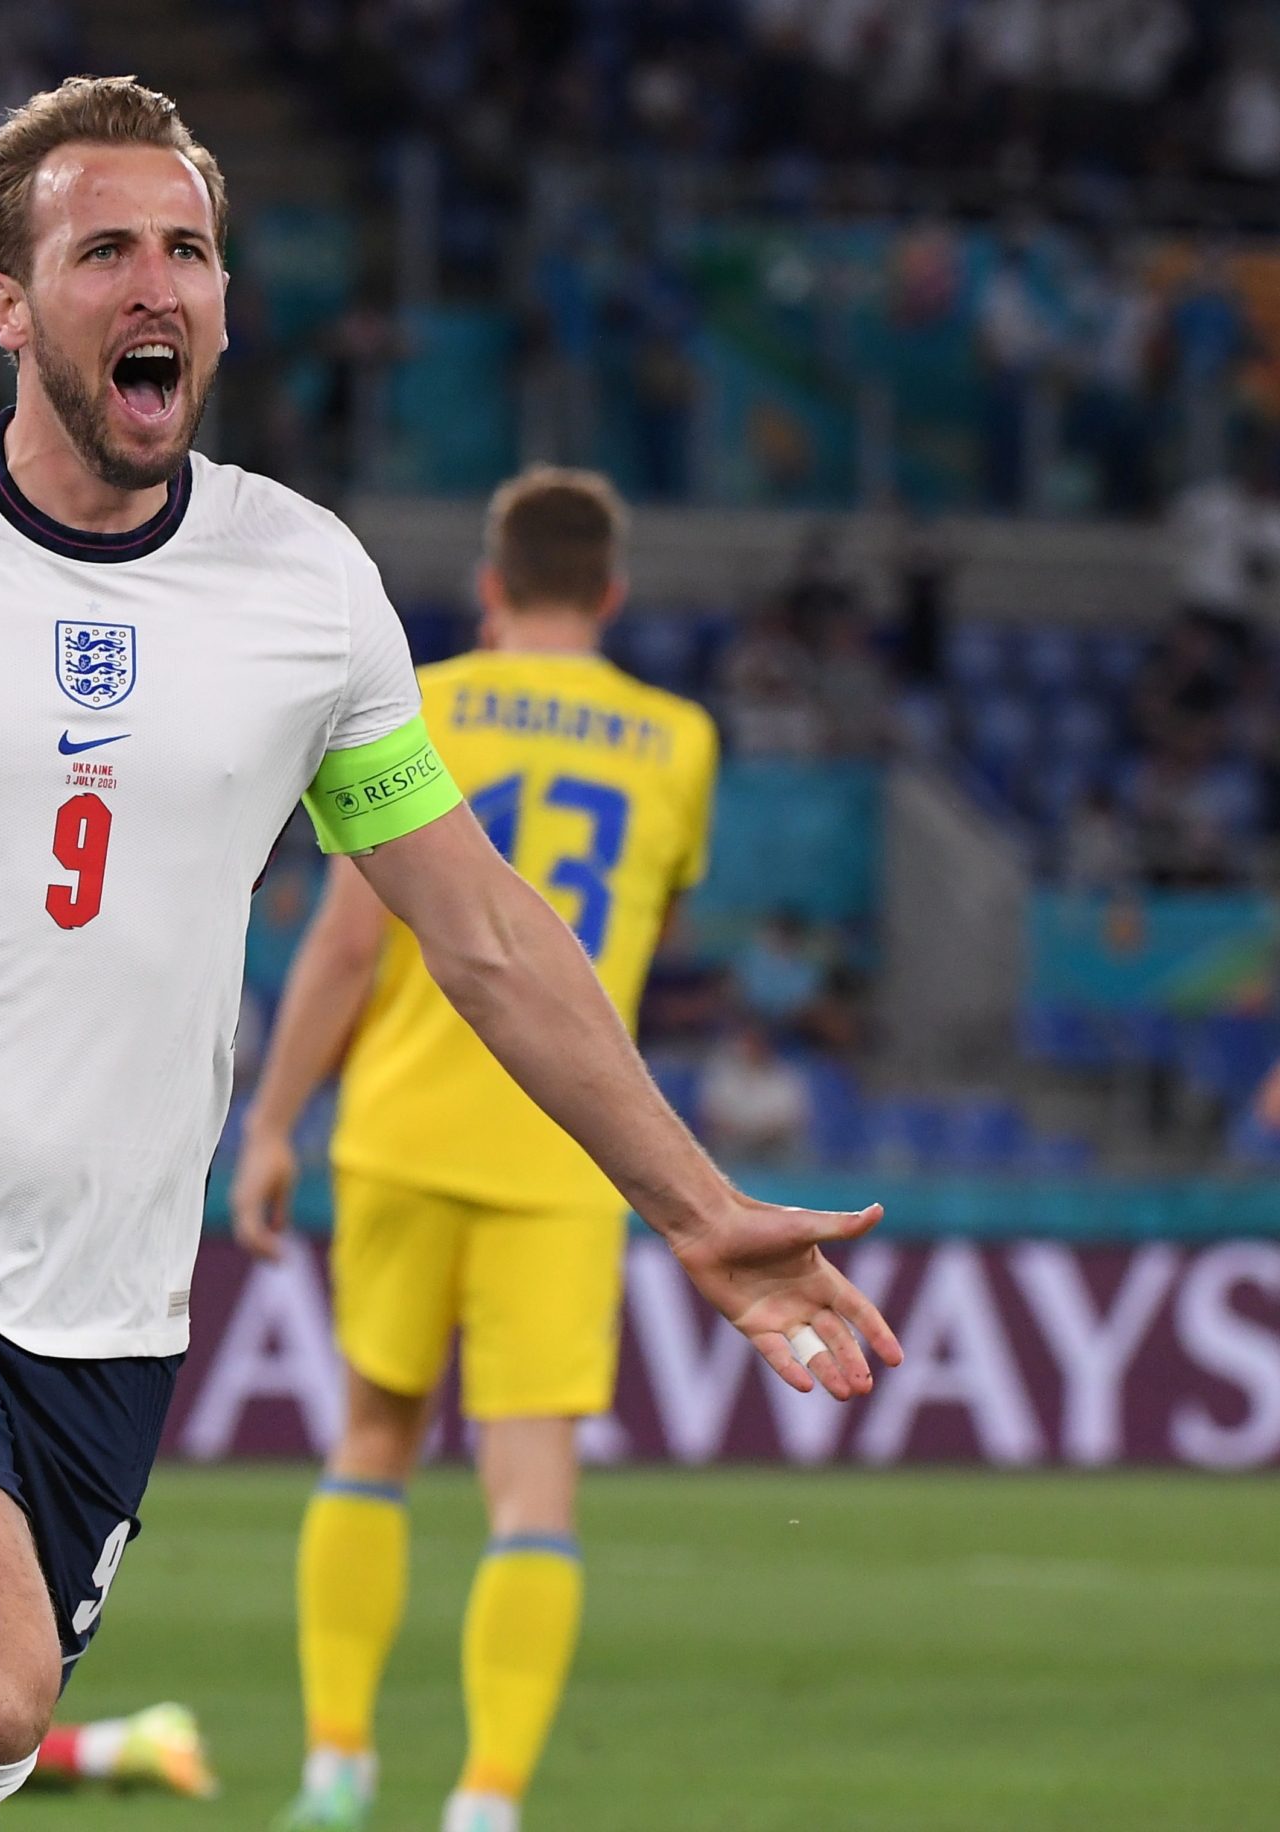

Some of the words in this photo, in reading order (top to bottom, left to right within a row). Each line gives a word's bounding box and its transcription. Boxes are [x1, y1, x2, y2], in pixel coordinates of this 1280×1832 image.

[65, 775, 71, 785] 3
[73, 776, 96, 787] JULY
[97, 778, 117, 789] 2021
[72, 762, 113, 776] UKRAINE
[363, 750, 438, 804] RESPEC
[45, 792, 112, 930] 9
[469, 770, 631, 965] 13
[180, 1232, 1280, 1468] AWAYS
[72, 1518, 131, 1635] 9
